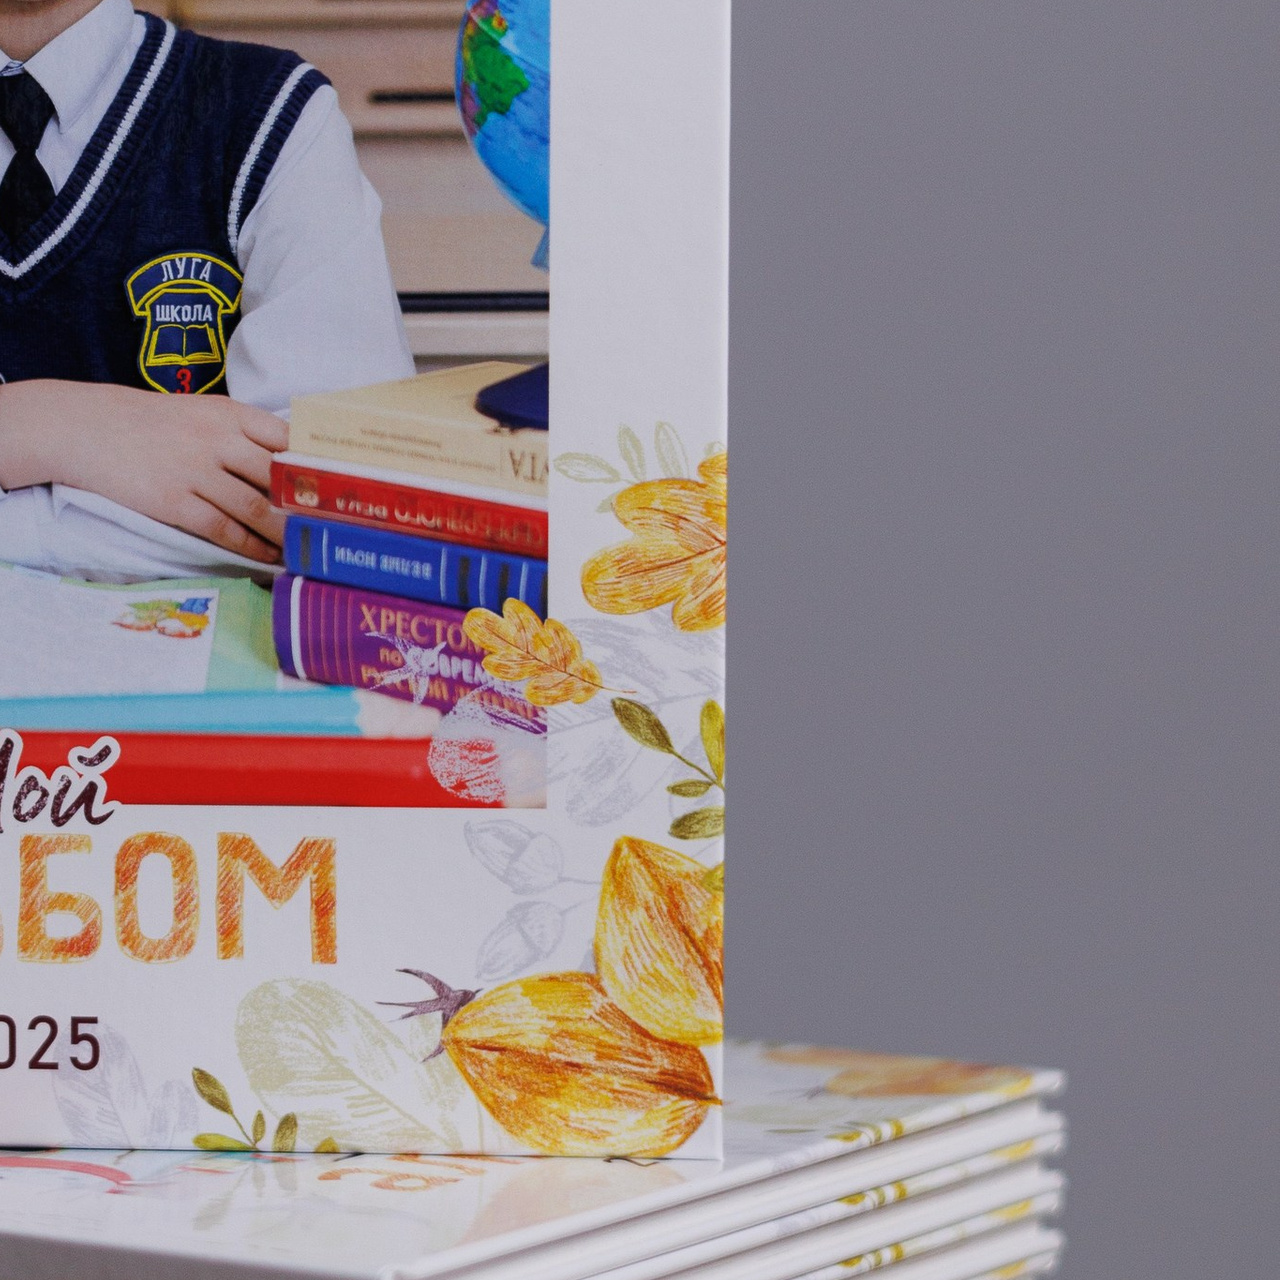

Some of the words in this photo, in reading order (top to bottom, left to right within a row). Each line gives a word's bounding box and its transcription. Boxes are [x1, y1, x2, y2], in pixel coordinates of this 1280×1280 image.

[161, 257, 212, 282] ЛУГА
[156, 304, 213, 322] ШКОЛА
[176, 368, 192, 394] 3
